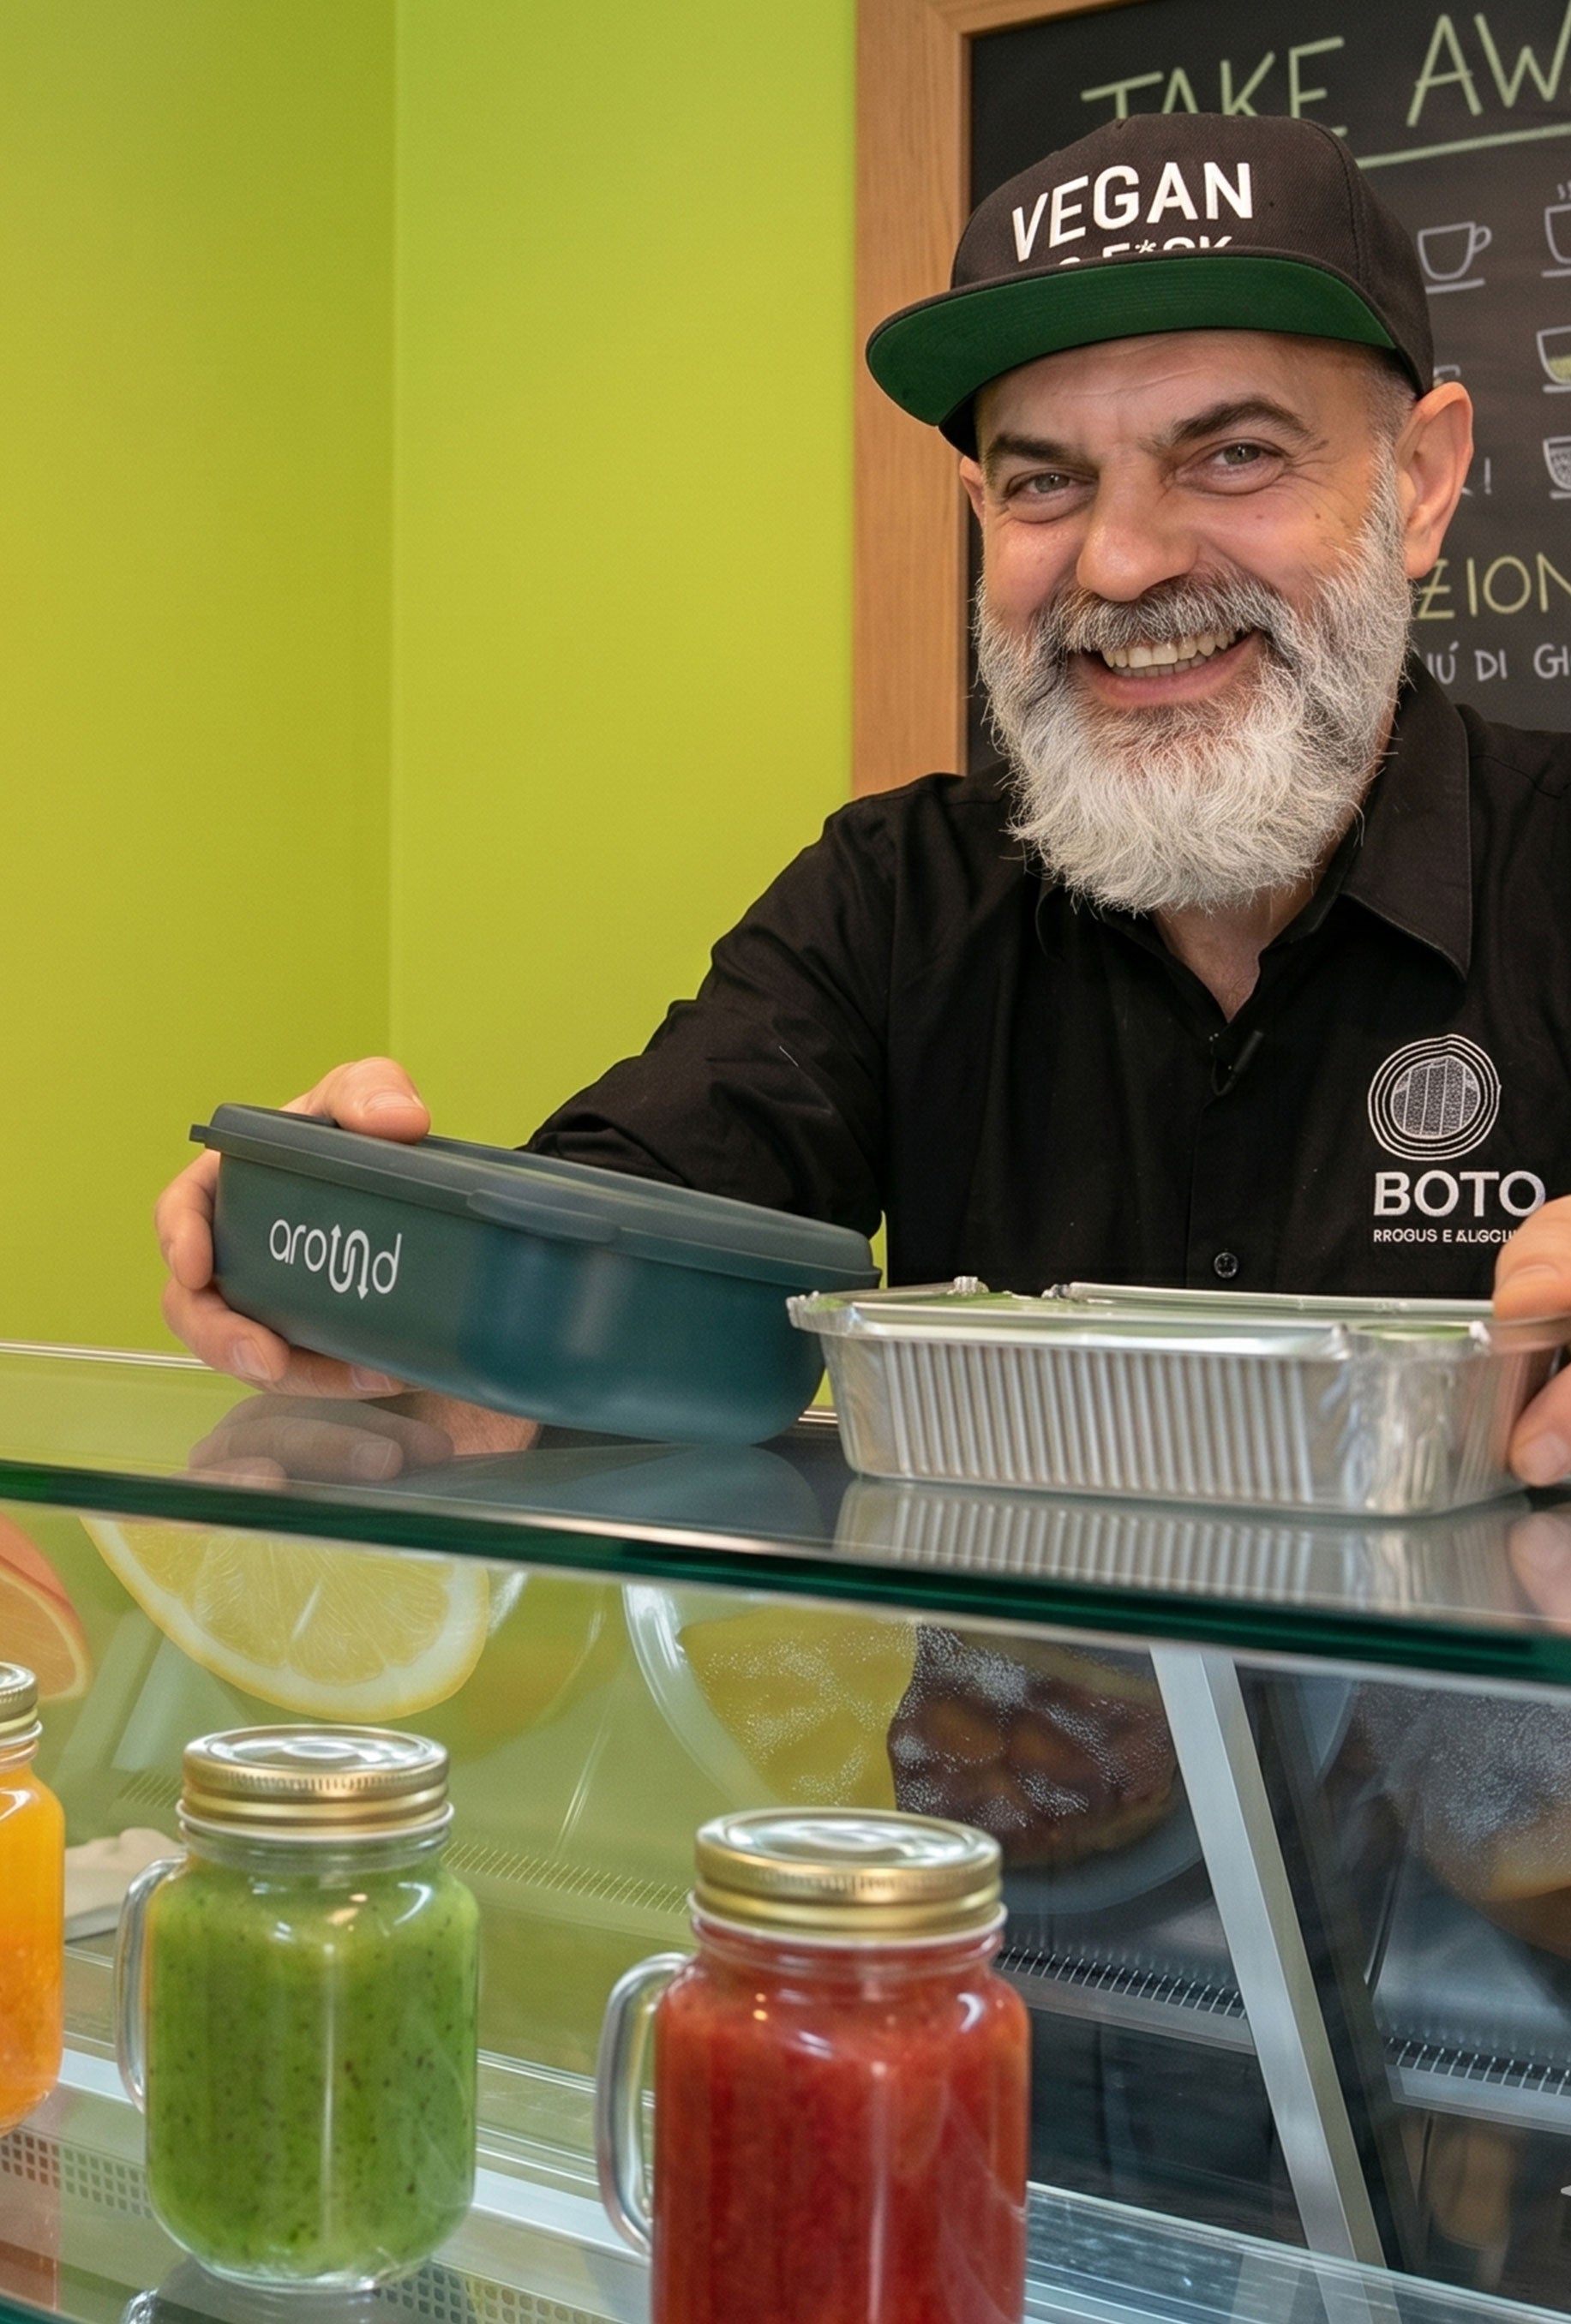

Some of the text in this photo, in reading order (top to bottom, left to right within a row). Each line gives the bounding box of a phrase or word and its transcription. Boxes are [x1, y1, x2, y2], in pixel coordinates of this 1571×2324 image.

[1011, 161, 1254, 263] VEGAN
[1474, 649, 1508, 681] DI
[1373, 1170, 1546, 1218] BOTO
[269, 1219, 402, 1300] around
[1442, 1228, 1453, 1243] E
